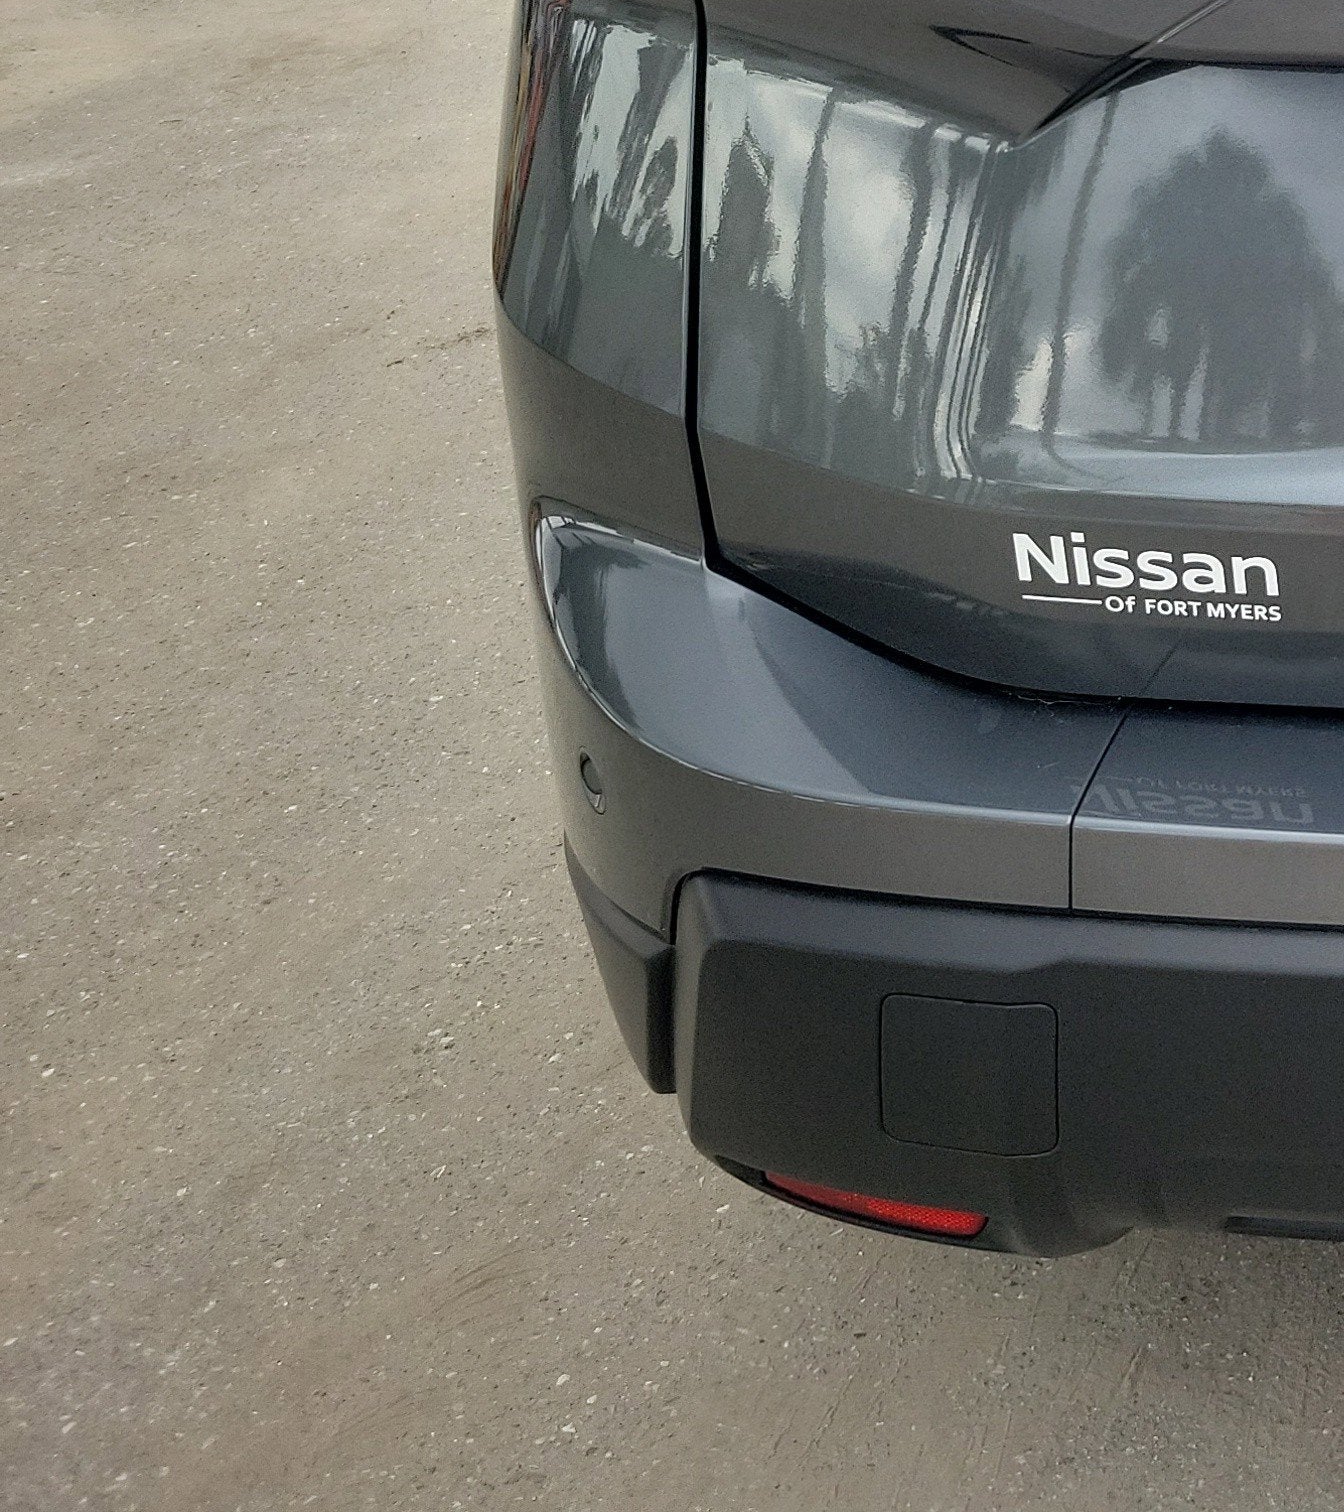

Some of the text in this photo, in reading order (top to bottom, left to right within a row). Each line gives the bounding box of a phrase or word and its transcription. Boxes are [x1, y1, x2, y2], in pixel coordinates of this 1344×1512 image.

[1012, 531, 1280, 596] Nissan
[1144, 598, 1202, 617] FORT
[1206, 601, 1283, 622] MYERS
